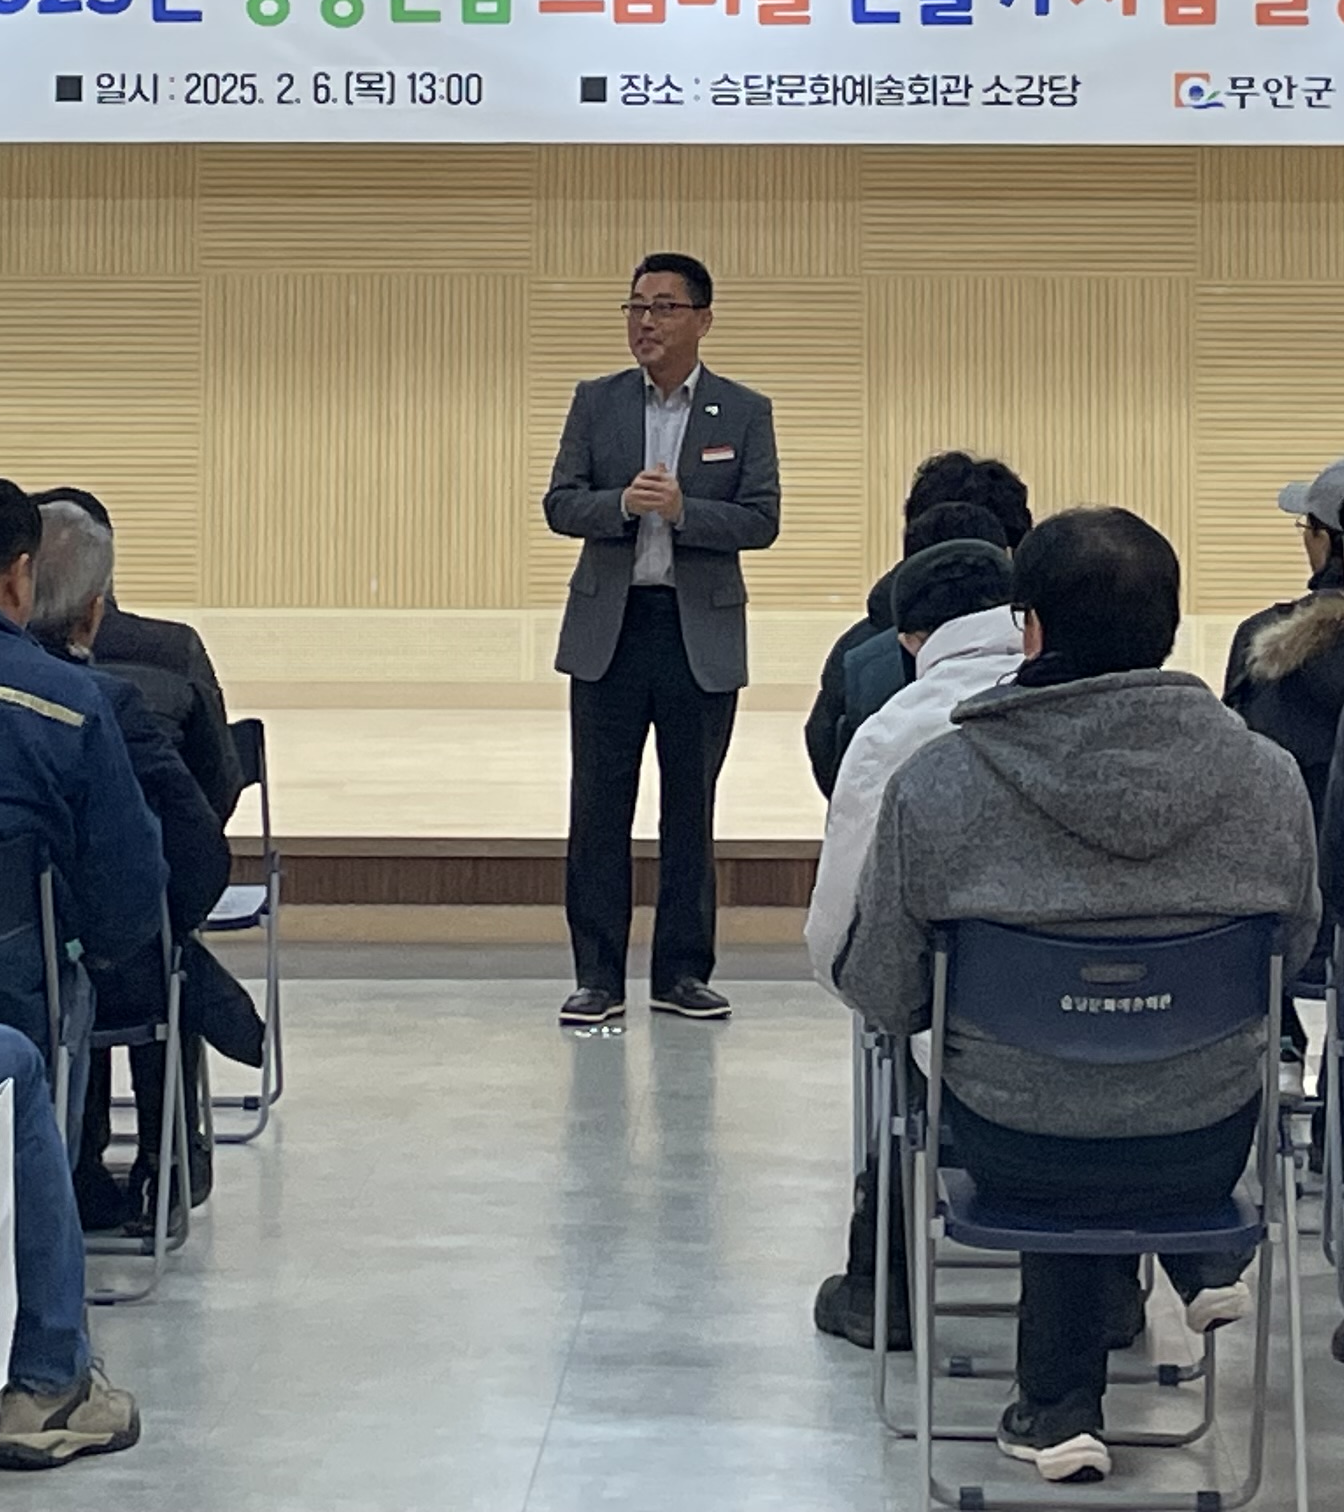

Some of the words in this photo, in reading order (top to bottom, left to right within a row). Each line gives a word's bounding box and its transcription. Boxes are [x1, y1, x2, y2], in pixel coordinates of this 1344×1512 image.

[96, 73, 159, 105] 일시
[184, 72, 264, 105] 2025.
[276, 72, 301, 105] 2.
[407, 71, 483, 106] 13:00
[620, 73, 685, 106] 장소
[710, 73, 975, 107] 승달문화예술회관
[981, 74, 1082, 107] 소강당
[1224, 74, 1337, 110] 무안군
